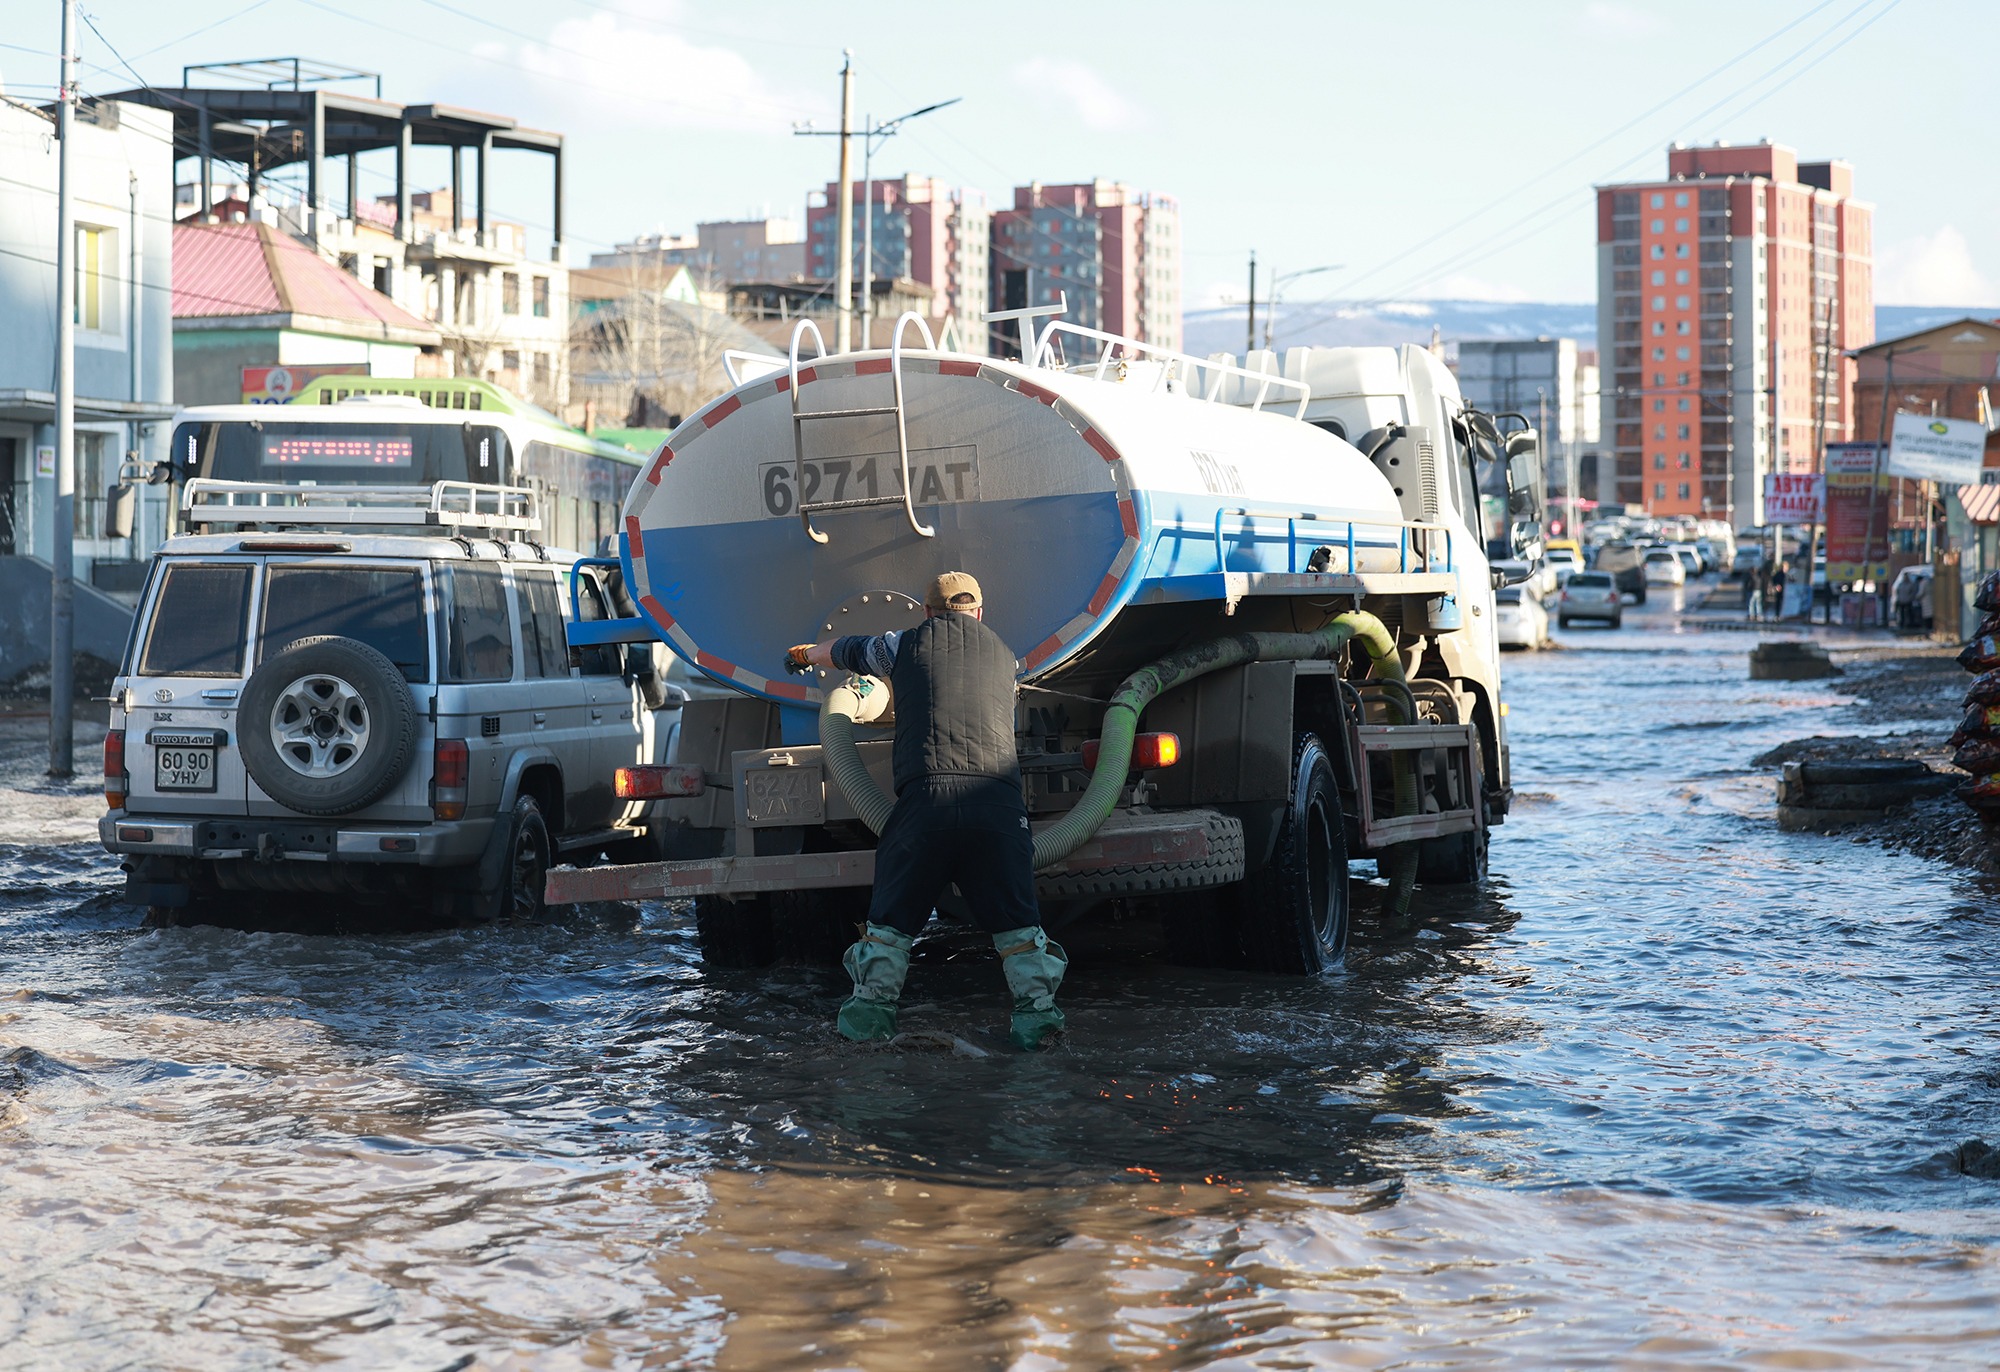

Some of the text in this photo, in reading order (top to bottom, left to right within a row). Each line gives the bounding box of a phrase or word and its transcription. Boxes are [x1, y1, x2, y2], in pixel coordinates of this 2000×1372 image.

[763, 457, 879, 517] 6271
[1774, 476, 1814, 493] АВТО
[154, 712, 172, 721] LX
[162, 752, 209, 770] 60 90
